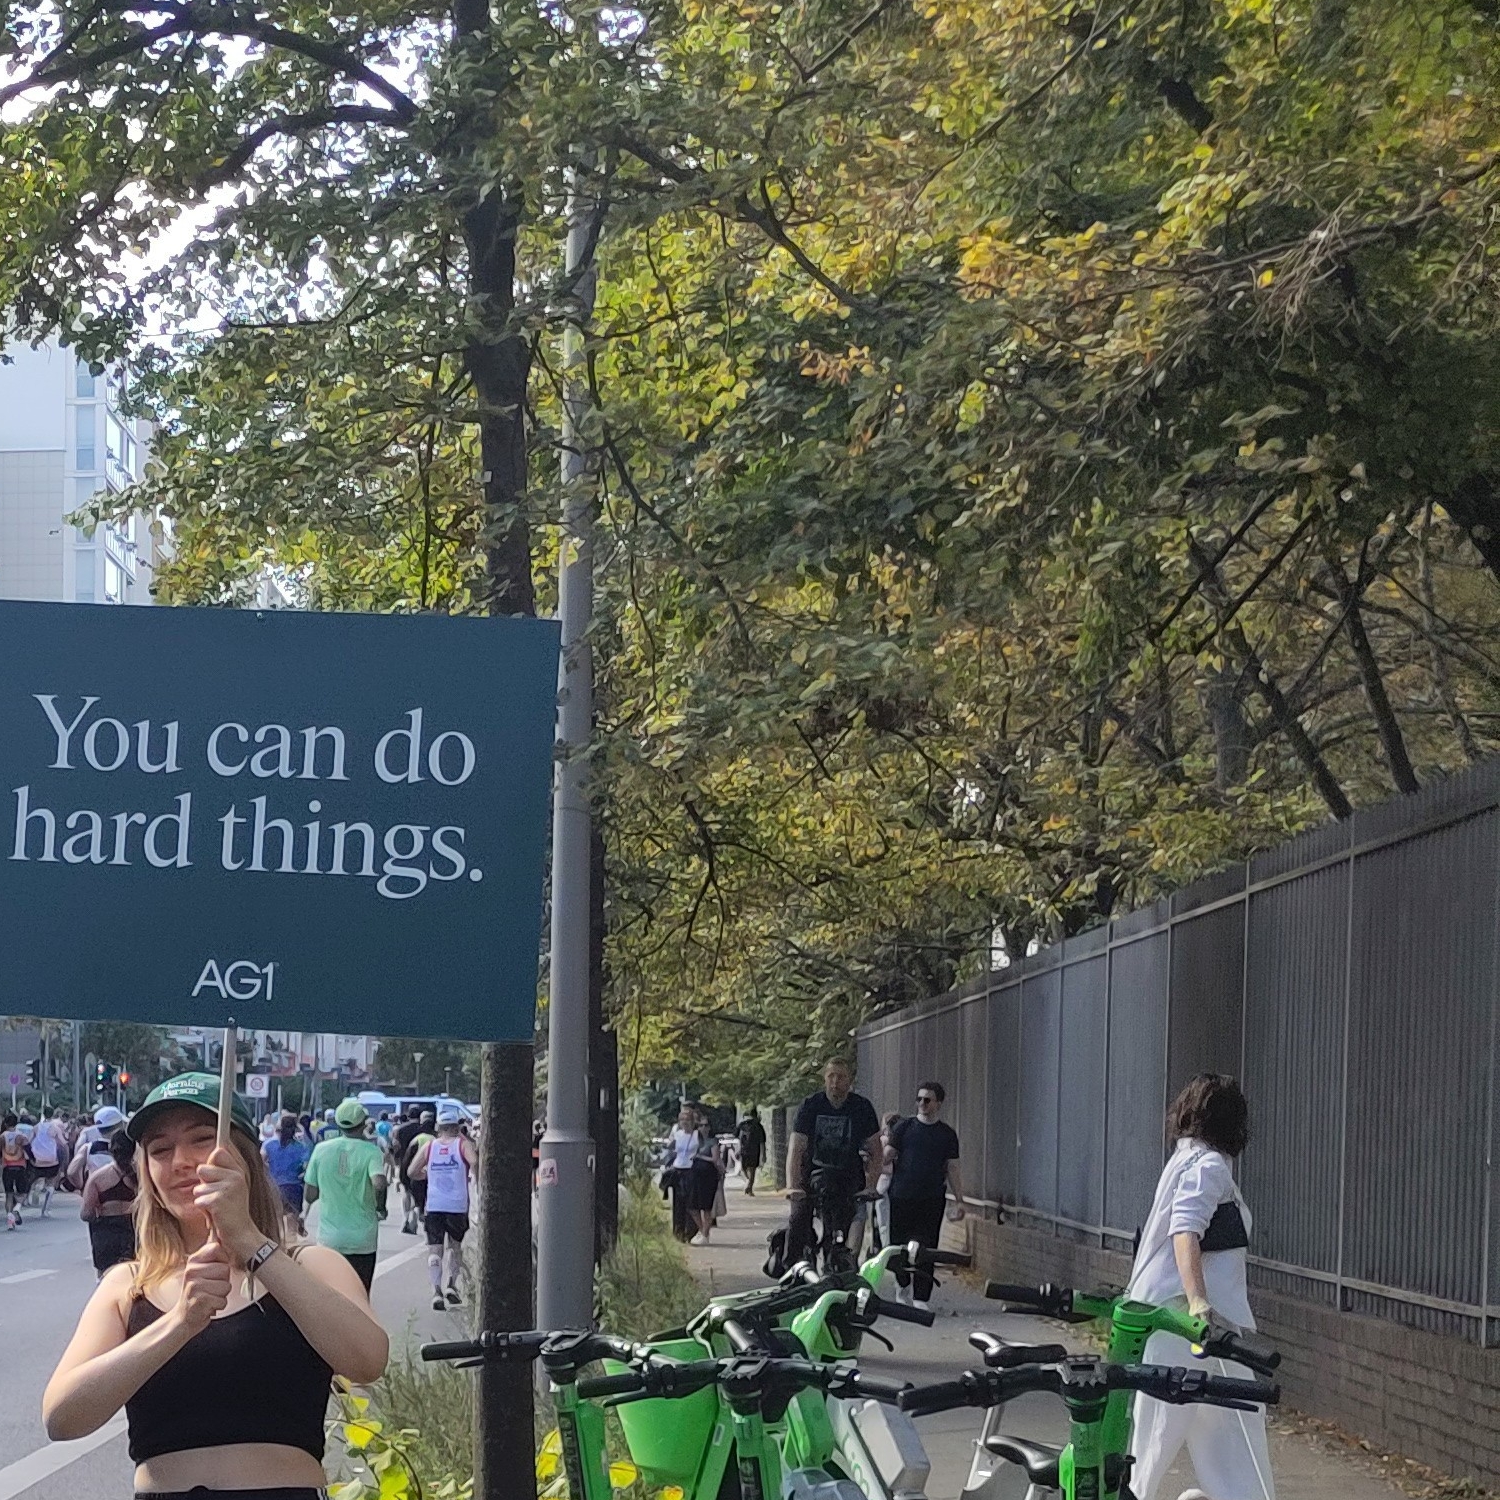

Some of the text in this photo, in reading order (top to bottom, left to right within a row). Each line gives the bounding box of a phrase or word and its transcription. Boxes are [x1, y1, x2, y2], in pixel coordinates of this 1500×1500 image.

[32, 693, 478, 786] You can do
[8, 785, 485, 900] hard things.
[191, 958, 279, 1002] AG1
[160, 1079, 206, 1095] Morning
[163, 1087, 199, 1099] Person
